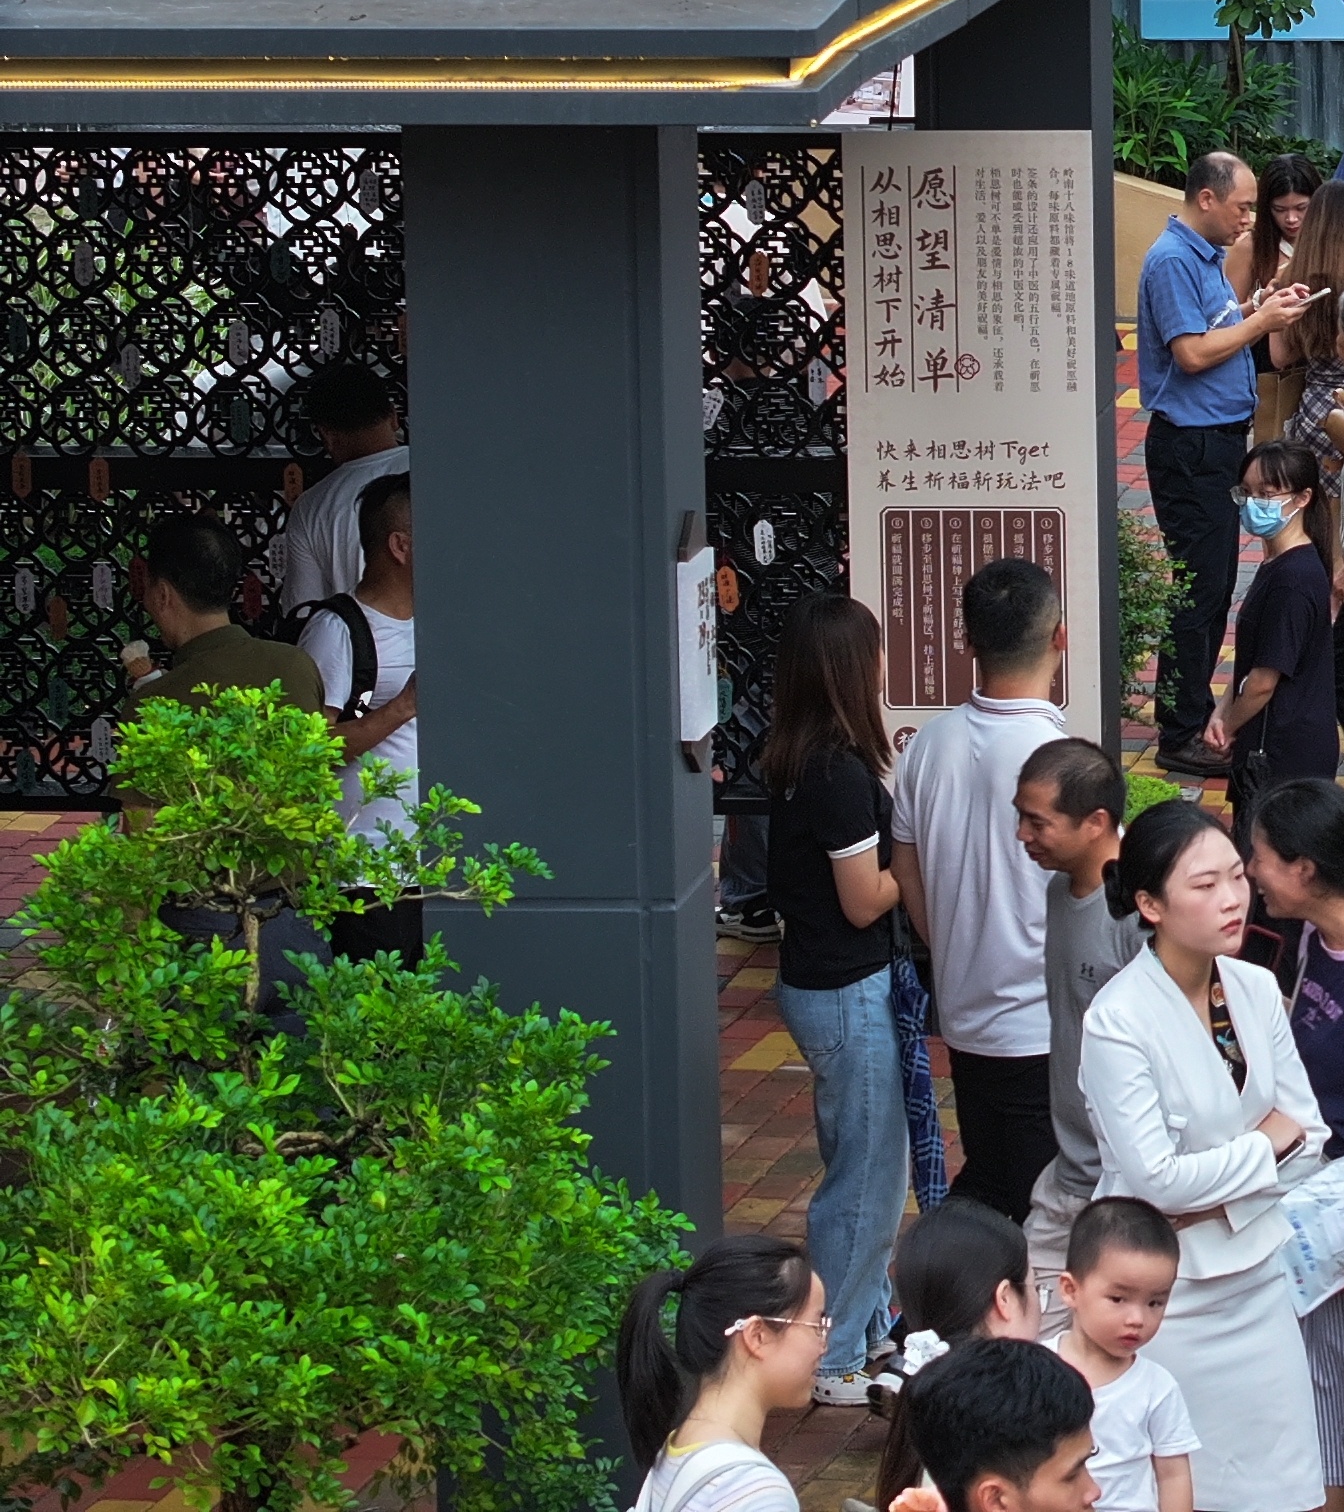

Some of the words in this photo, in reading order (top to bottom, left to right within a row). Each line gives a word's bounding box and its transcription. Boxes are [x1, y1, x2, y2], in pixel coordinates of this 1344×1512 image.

[868, 167, 906, 390] 从相思树下开始
[911, 167, 957, 394] 愿望清单
[876, 438, 1050, 466] 快来相思树下get
